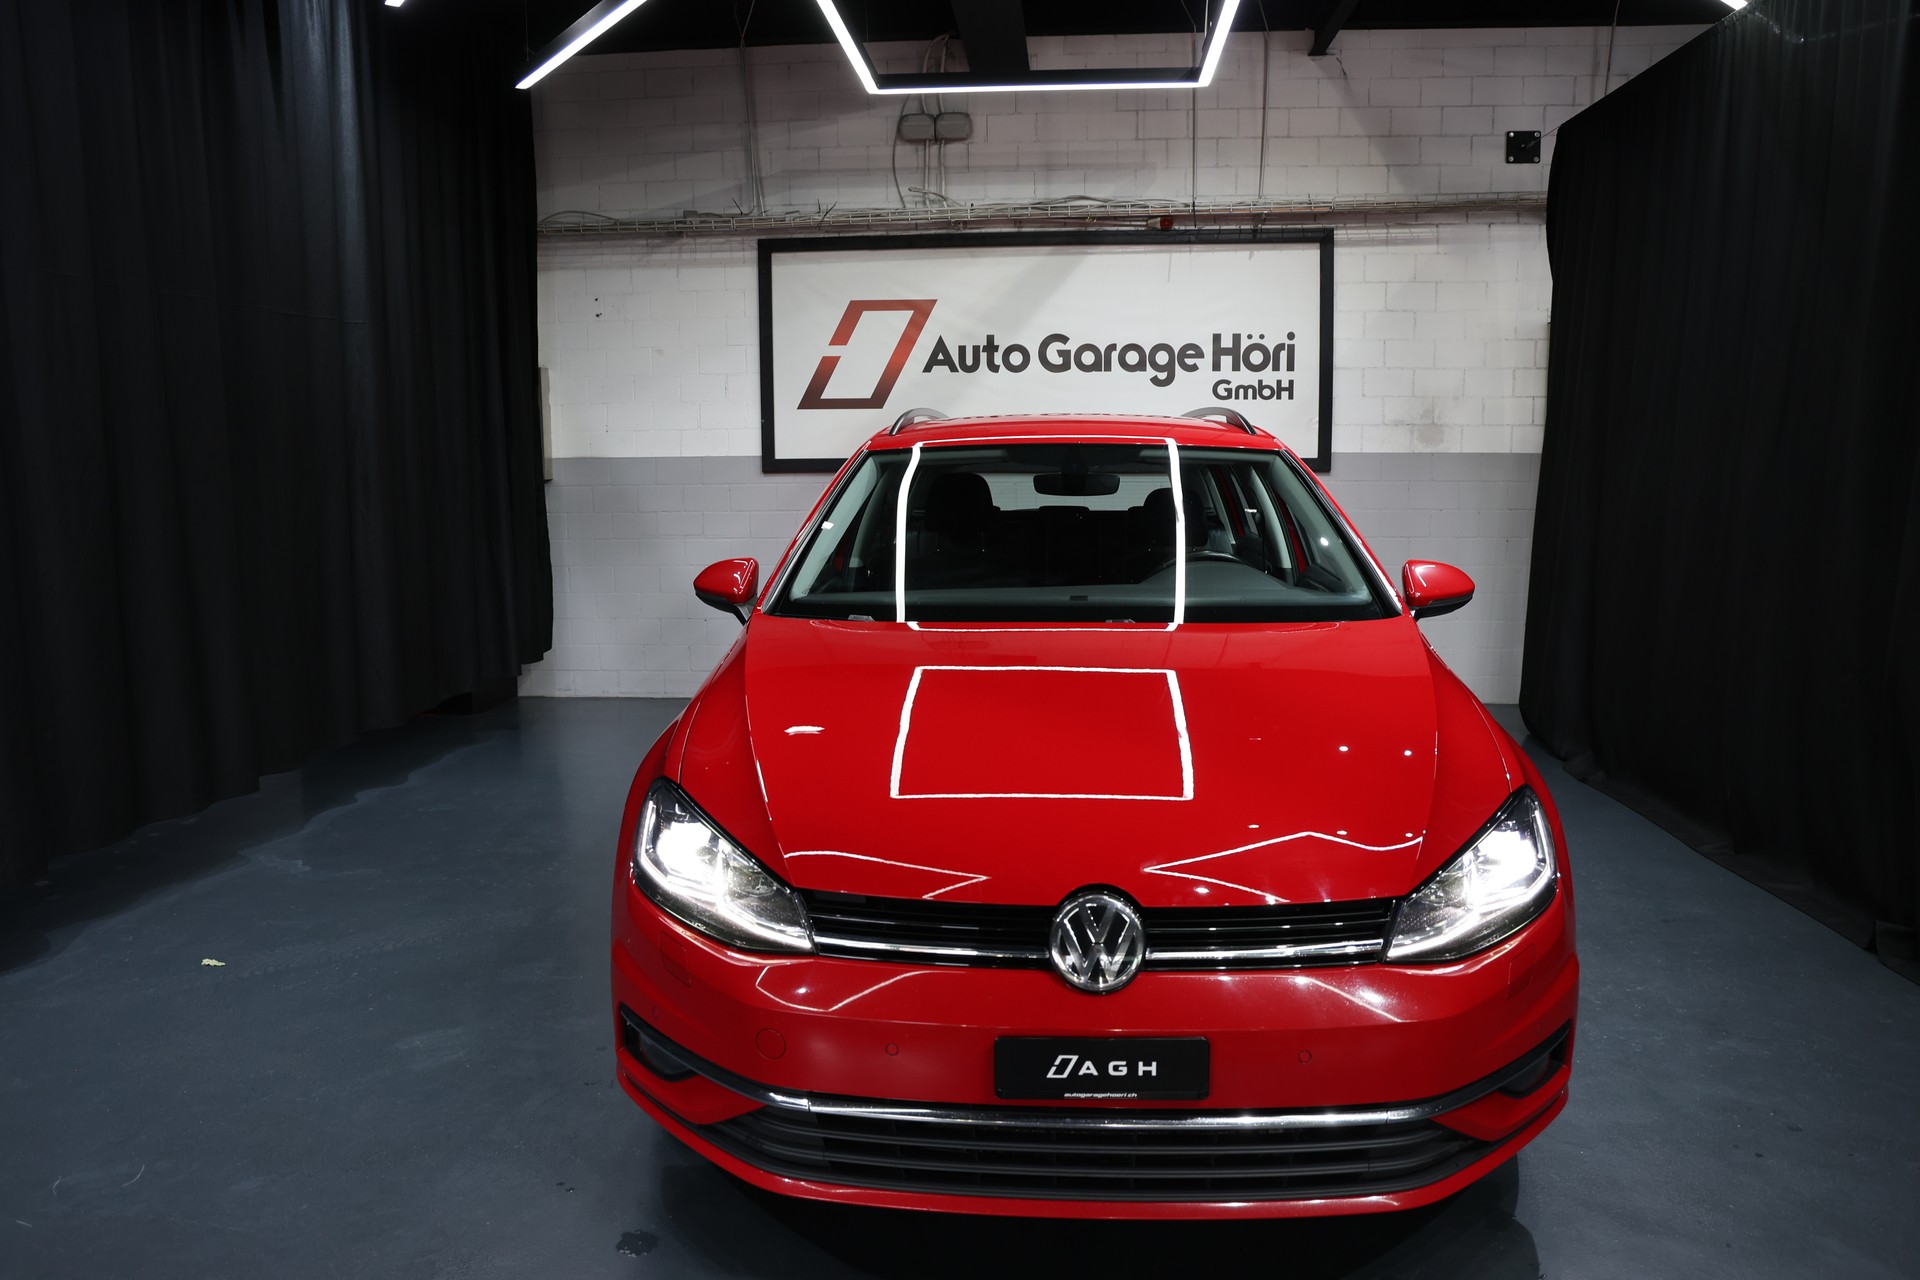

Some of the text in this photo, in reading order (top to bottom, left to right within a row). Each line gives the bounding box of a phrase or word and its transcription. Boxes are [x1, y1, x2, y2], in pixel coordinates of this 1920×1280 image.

[922, 331, 1296, 388] Auto Garage Höri
[1212, 379, 1295, 401] GmbH
